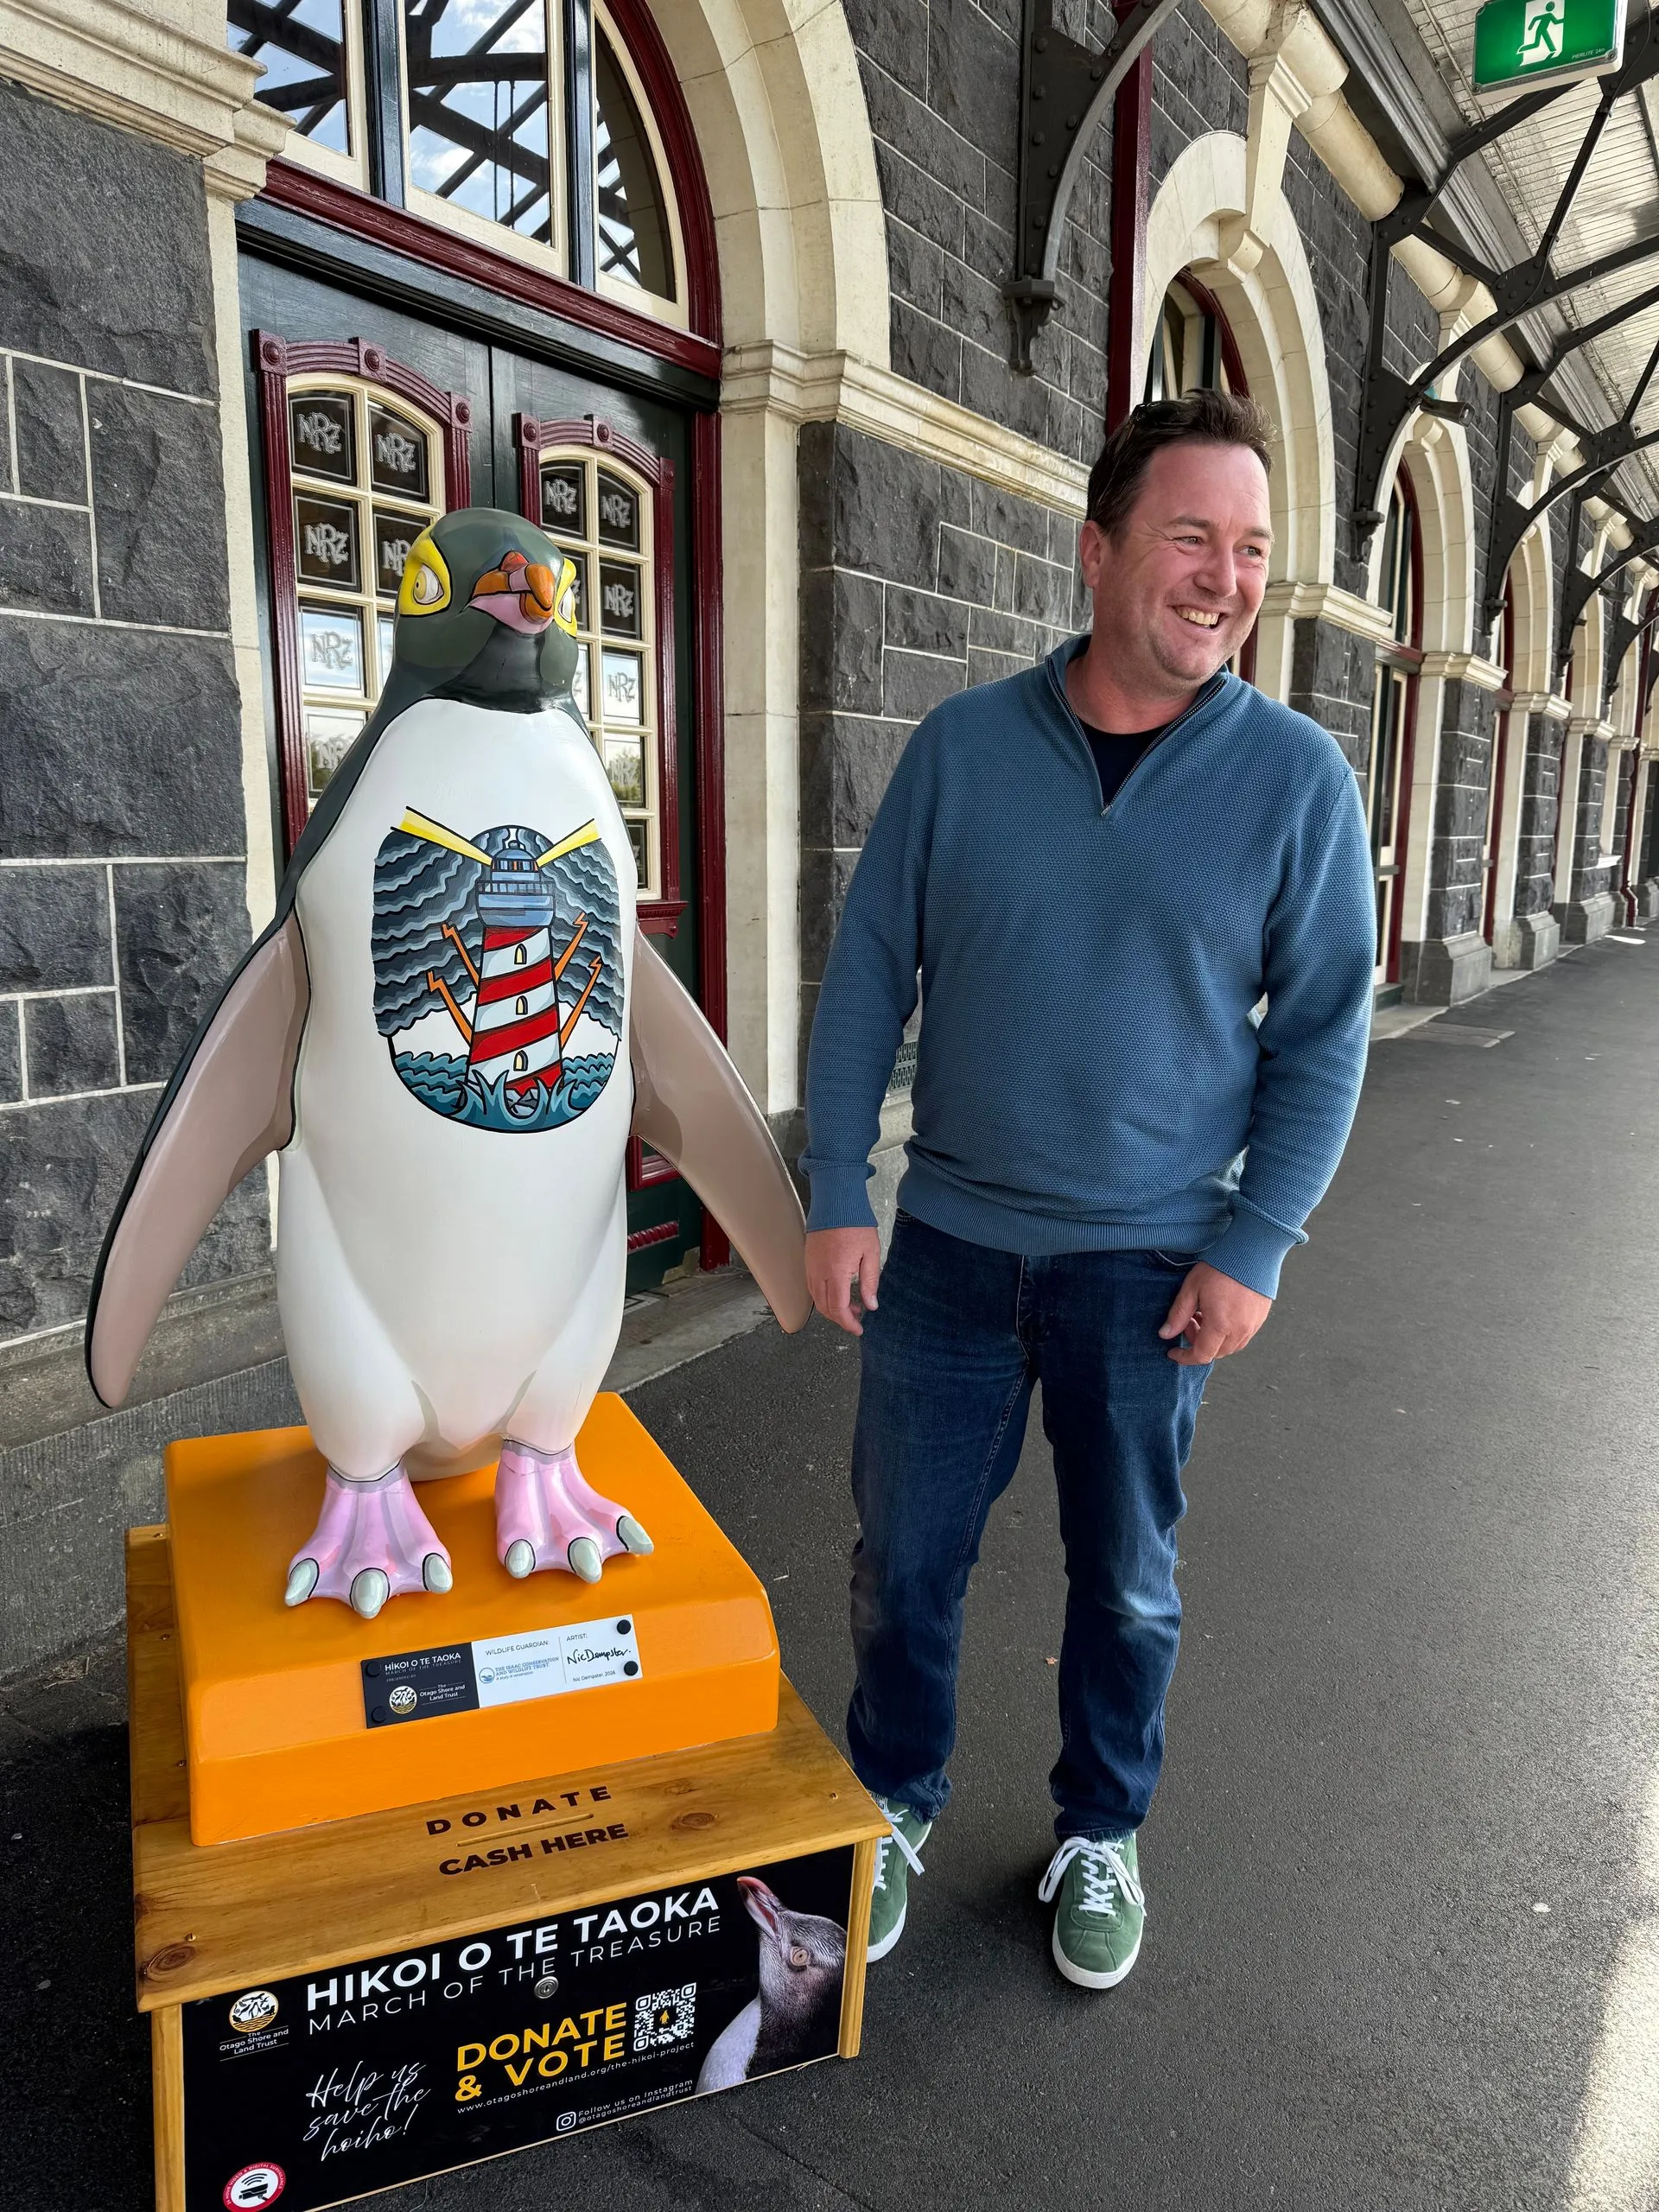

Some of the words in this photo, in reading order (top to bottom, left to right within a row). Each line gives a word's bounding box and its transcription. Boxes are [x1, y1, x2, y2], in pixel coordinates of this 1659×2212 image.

[432, 1652, 461, 1662] TAOKA
[486, 1646, 514, 1656] WILDLIFE
[567, 1633, 588, 1642] ARTIST:
[432, 1659, 461, 1668] TREASURE
[425, 1785, 612, 1836] DONATE
[439, 1841, 534, 1876] CASH
[540, 1823, 630, 1855] HERE
[307, 1952, 441, 2012] HIKOI
[458, 1942, 492, 1971] O
[506, 1923, 558, 1960] TE
[573, 1886, 719, 1943] TAOKA
[308, 1993, 426, 2036] MARCH
[443, 1974, 485, 1999] OF
[499, 1957, 556, 1986] THE
[570, 1915, 721, 1967] TREASURE
[219, 2041, 245, 2051] Otago
[247, 2034, 271, 2044] Shore
[273, 2029, 289, 2037] and
[233, 2044, 255, 2055] Land
[256, 2039, 277, 2048] Trust
[456, 2002, 627, 2072] DONATE
[306, 2060, 385, 2108] Help
[391, 2062, 427, 2088] us
[454, 2074, 483, 2101] &
[504, 2032, 626, 2087] VOTE
[457, 2042, 695, 2114] www.otagoshoreandland.org/the-hikoi-project
[302, 2103, 379, 2142] save
[372, 2077, 431, 2121] the
[578, 2103, 611, 2117] Follow
[645, 2080, 693, 2098] Instagram
[579, 2086, 693, 2124] @otagoshoreandlandtrust
[321, 2103, 419, 2162] hoiho!
